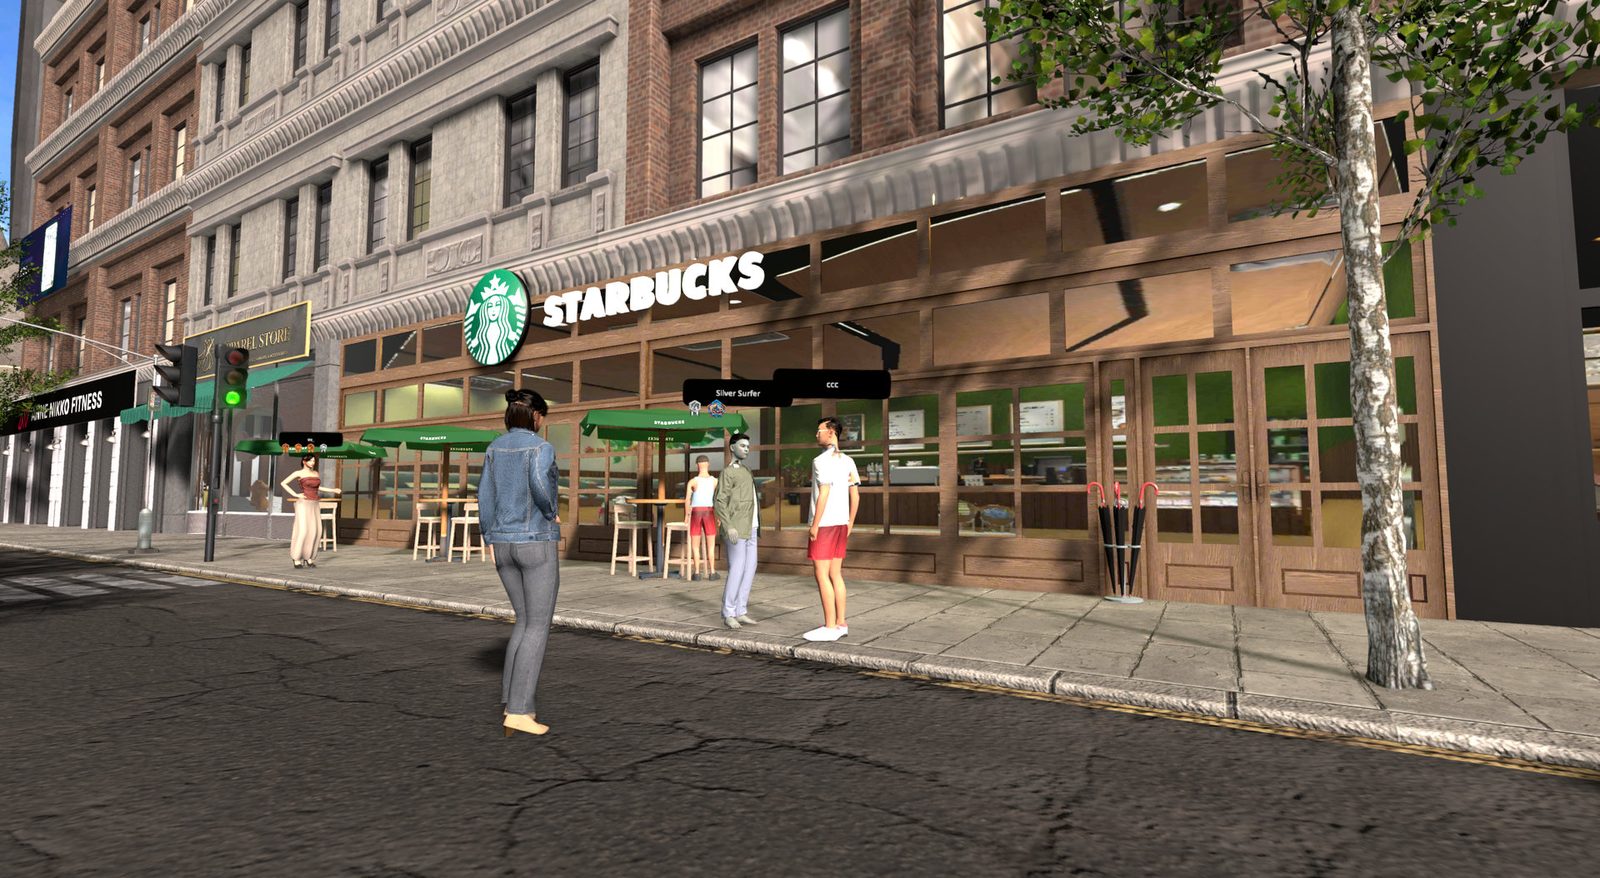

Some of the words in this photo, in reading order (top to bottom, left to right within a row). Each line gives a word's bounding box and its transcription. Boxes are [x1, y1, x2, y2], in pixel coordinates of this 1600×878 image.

[543, 251, 765, 327] STARBUCKS
[258, 327, 290, 348] STORE
[48, 398, 70, 418] NIKKO
[70, 391, 103, 414] FITNESS
